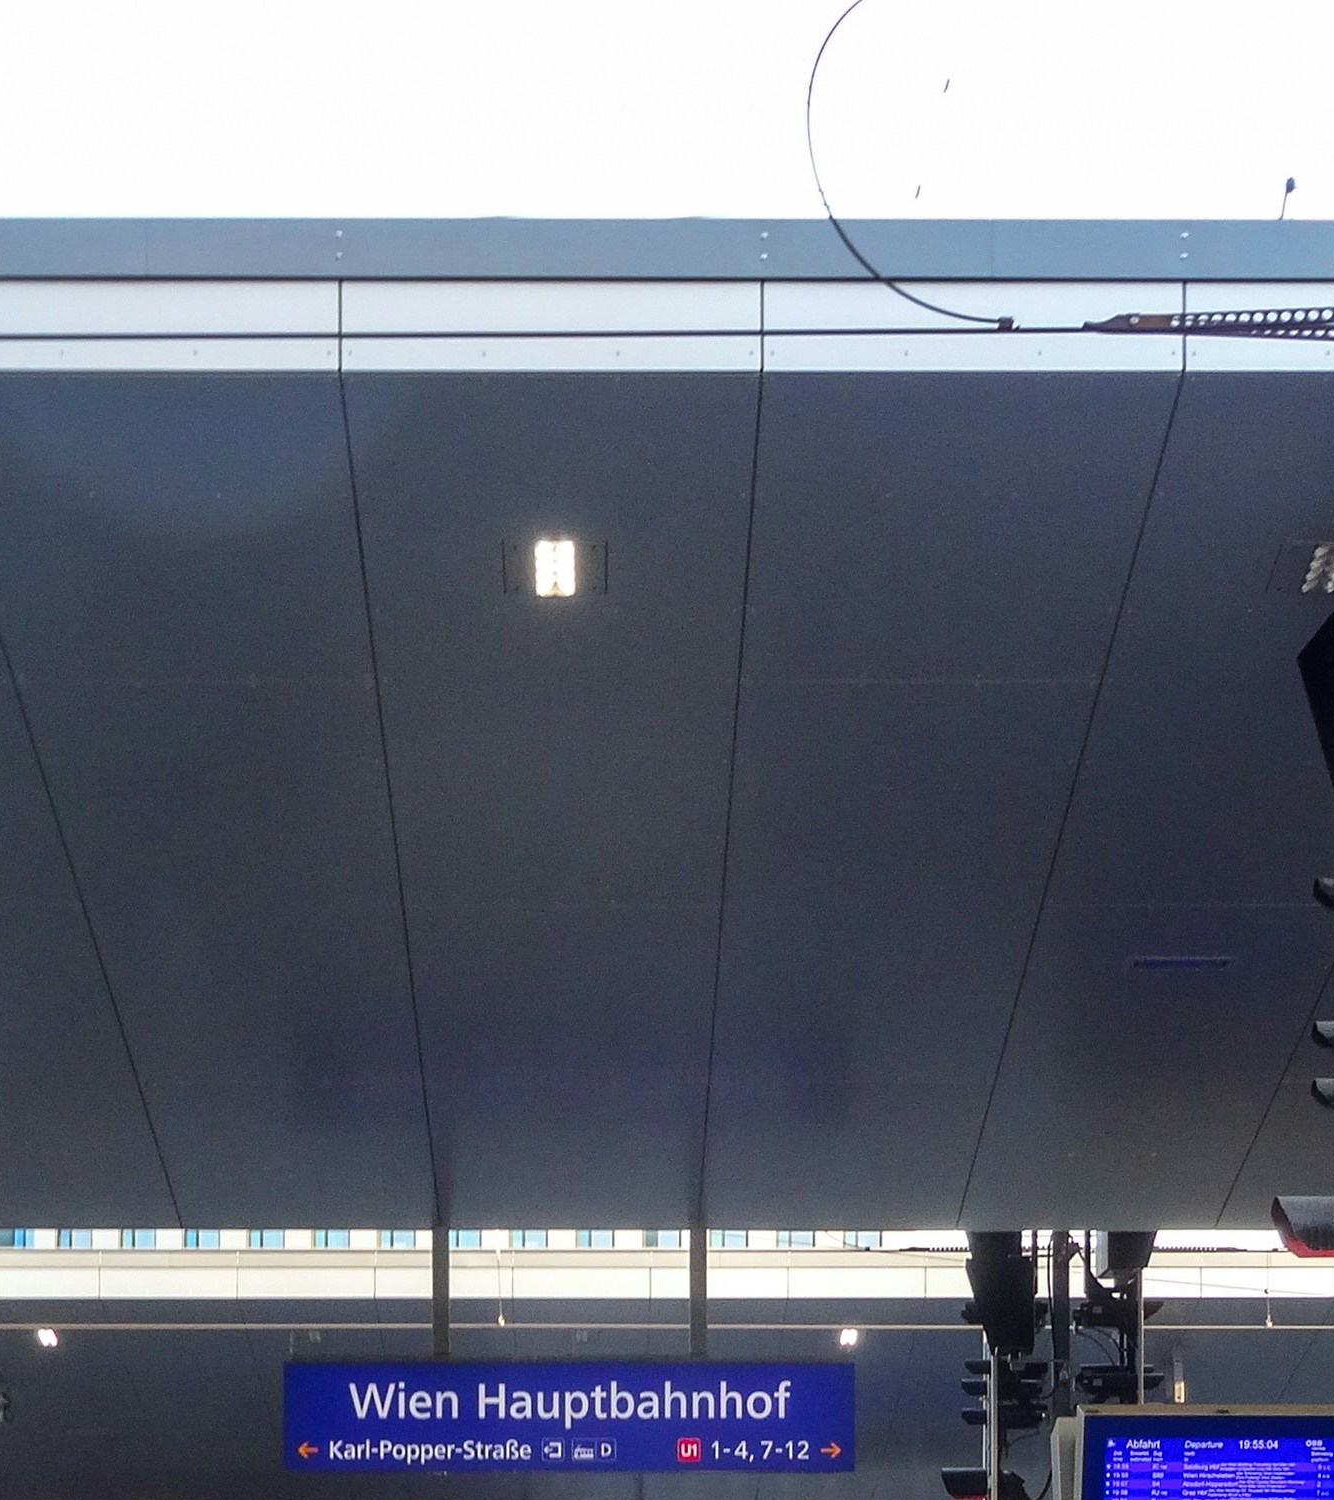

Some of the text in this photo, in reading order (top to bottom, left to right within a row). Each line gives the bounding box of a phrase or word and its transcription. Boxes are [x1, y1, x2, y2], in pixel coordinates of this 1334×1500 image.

[348, 1380, 792, 1430] Wien Hauptbahnhof
[328, 1438, 532, 1465] Karl-Popper-Straße
[600, 1442, 612, 1457] D
[680, 1444, 698, 1457] U1
[760, 1440, 810, 1460] 7-12
[1126, 1439, 1161, 1450] Abfahrt
[1184, 1440, 1224, 1450] Departure
[1239, 1439, 1279, 1450] 19:55:04
